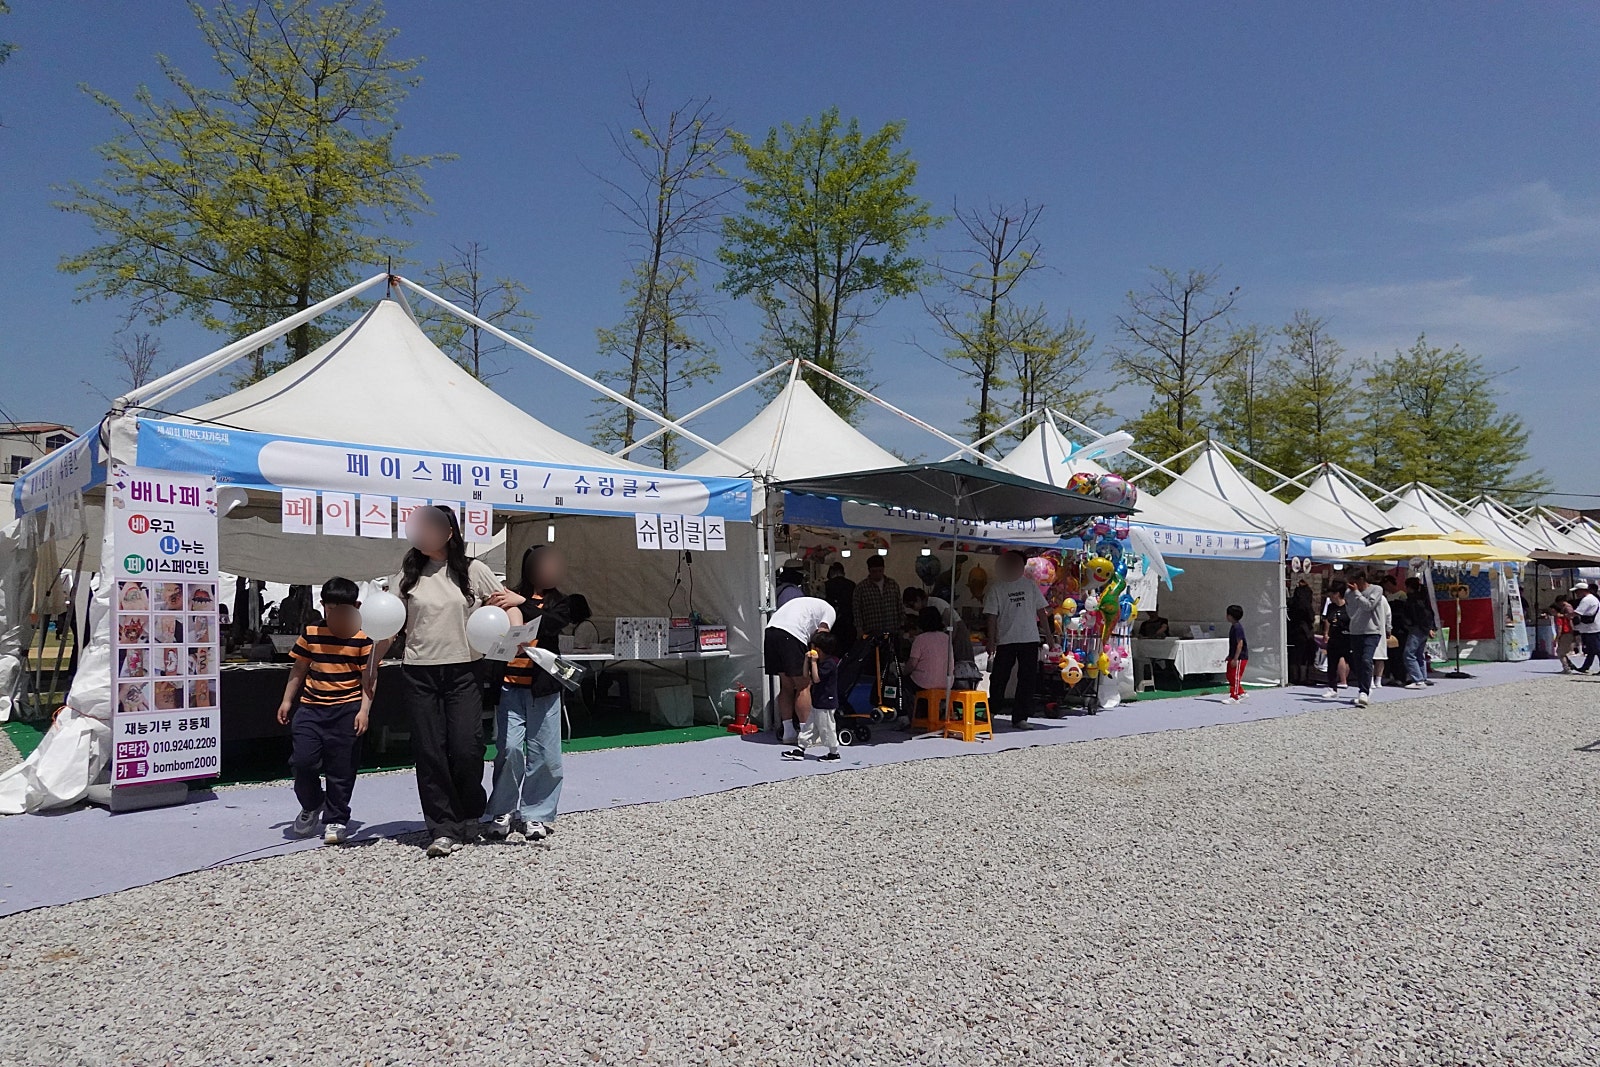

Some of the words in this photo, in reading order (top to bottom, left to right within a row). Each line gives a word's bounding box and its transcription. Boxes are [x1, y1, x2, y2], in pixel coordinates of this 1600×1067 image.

[346, 452, 519, 490] 페이스페인팅
[574, 475, 661, 499] 슈링클즈
[131, 480, 200, 507] 배나페
[130, 517, 176, 533] 배우고
[638, 522, 725, 544] 슈링클즈
[163, 538, 205, 554] 나누는
[126, 556, 209, 575] 페이스페인팅
[125, 719, 172, 735] 재능기부
[178, 717, 210, 731] 공동체
[118, 742, 147, 758] 연락처
[153, 736, 217, 754] 010.9240.2209
[153, 755, 217, 774] bombom2000
